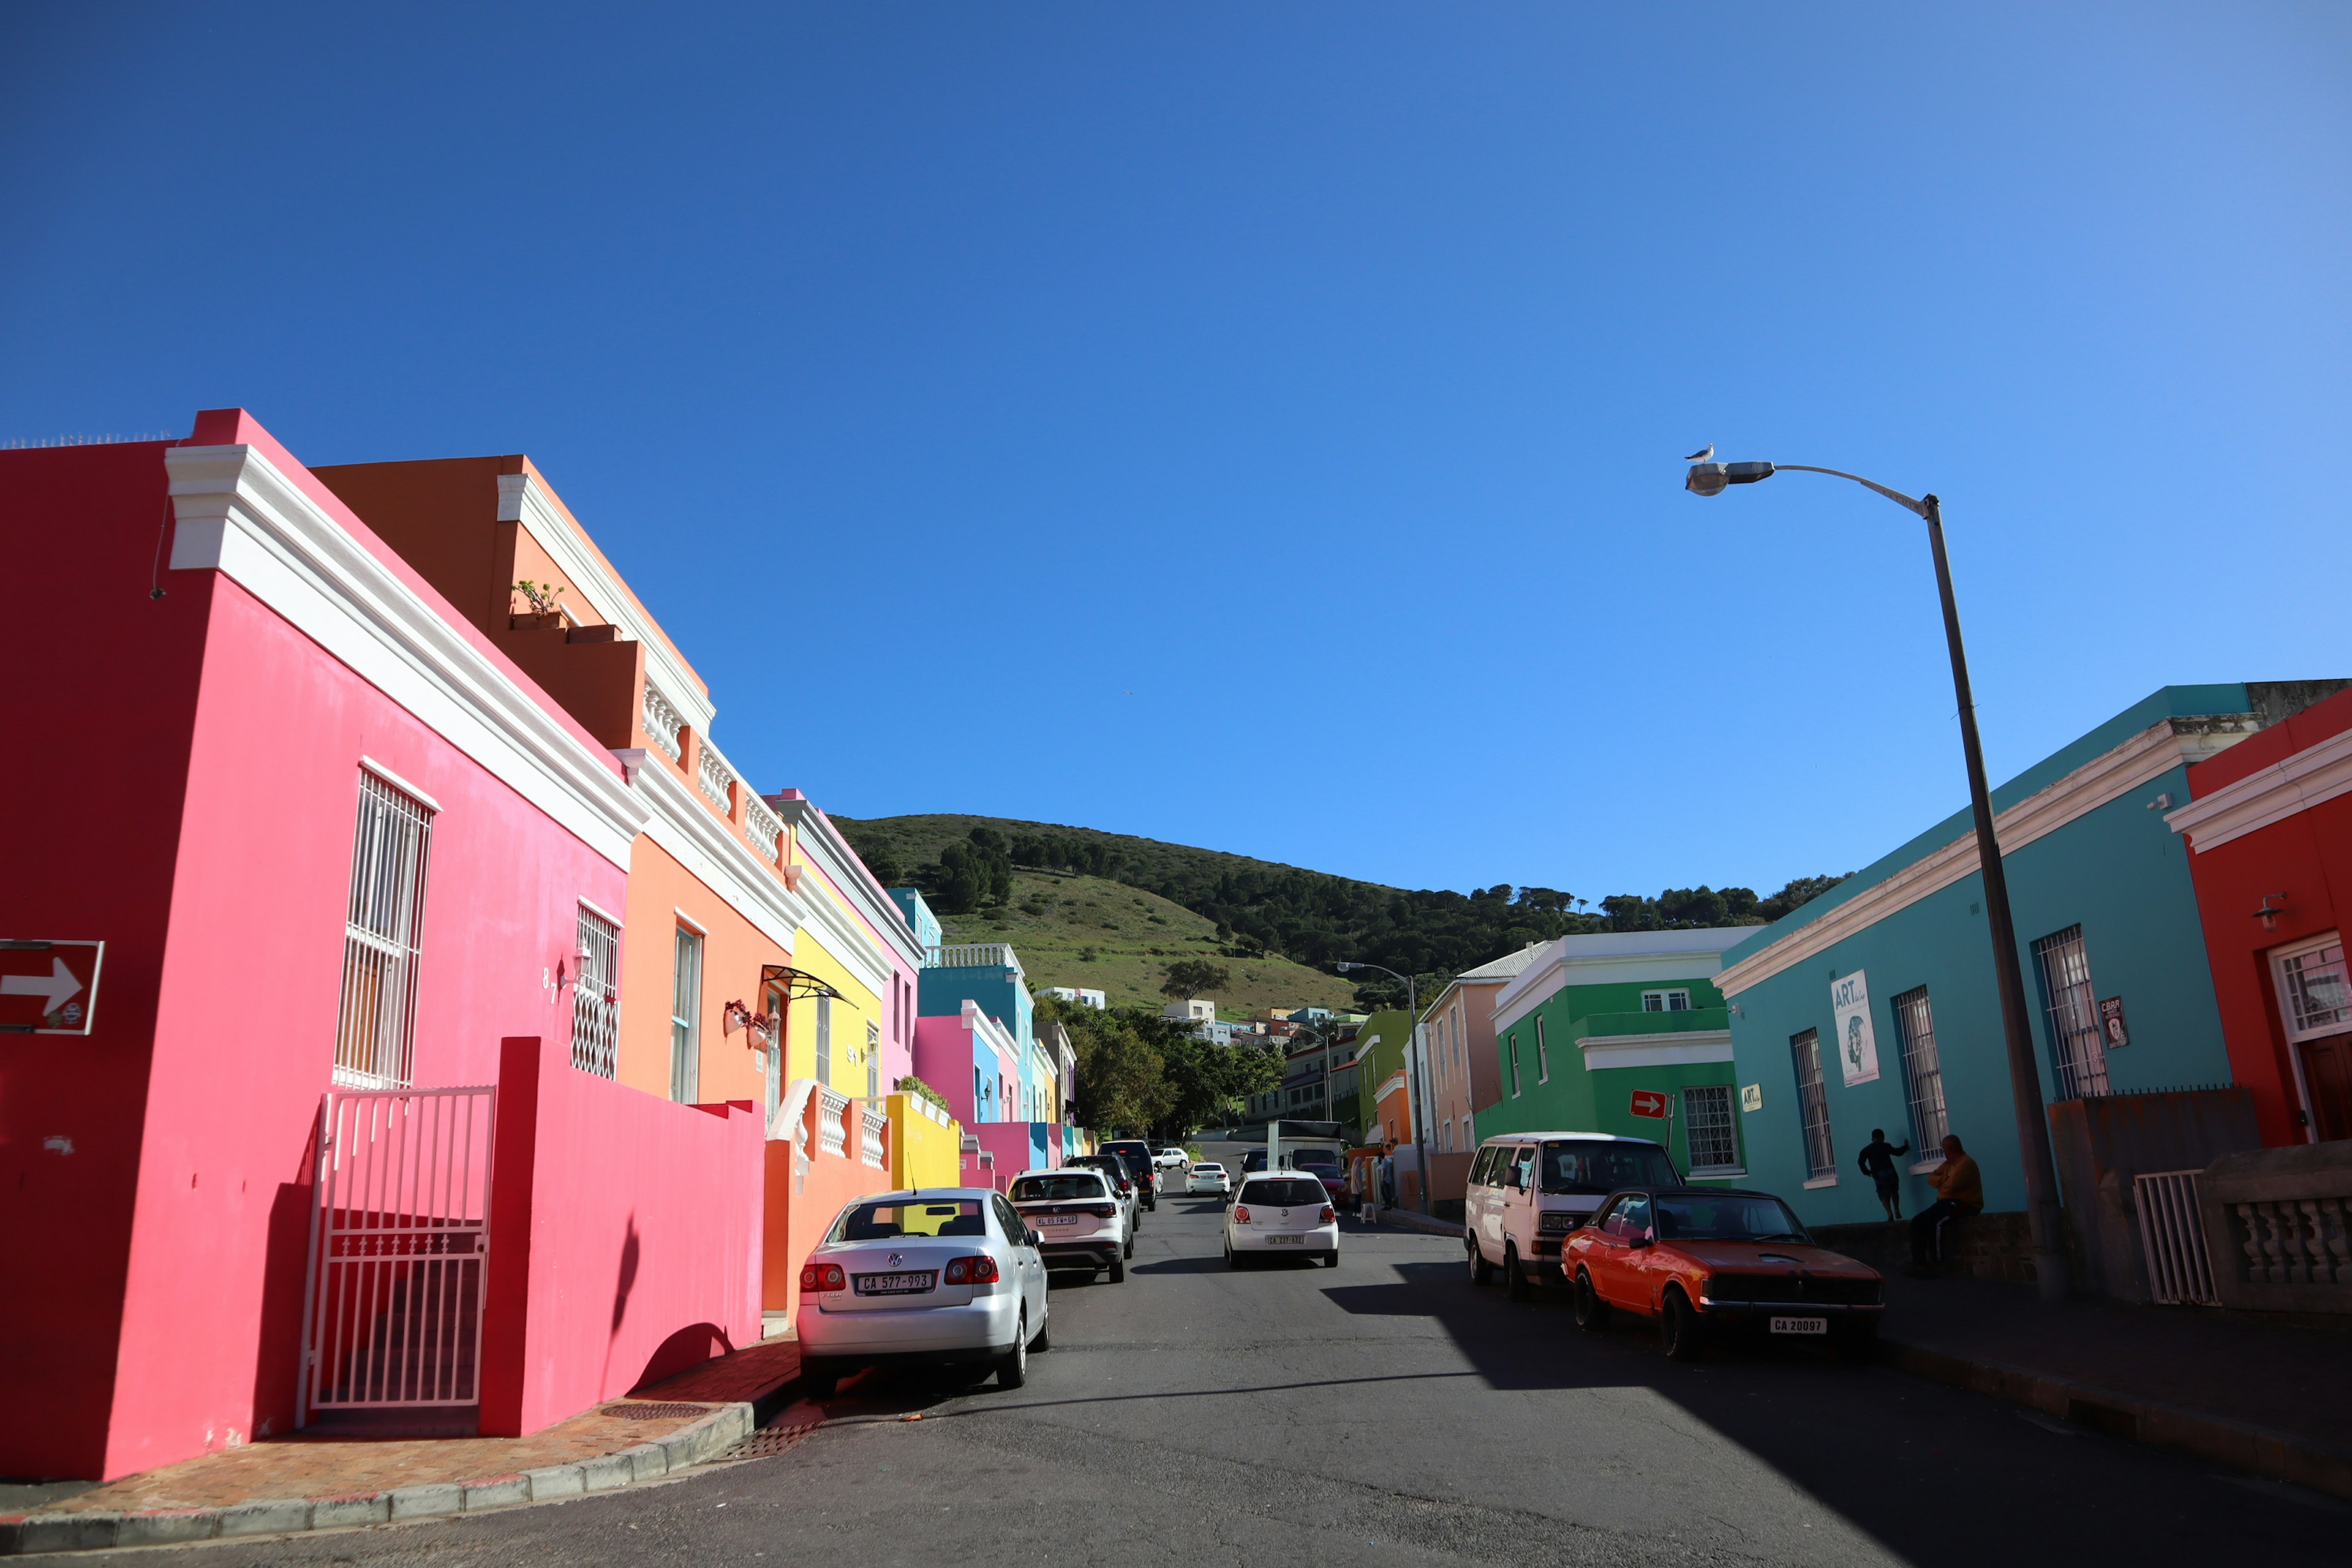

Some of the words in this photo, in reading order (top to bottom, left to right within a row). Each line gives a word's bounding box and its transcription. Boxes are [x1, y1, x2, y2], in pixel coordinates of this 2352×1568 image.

[543, 967, 557, 1005] 87
[1836, 979, 1855, 1010] ART
[847, 1044, 858, 1067] 91
[1744, 1088, 1754, 1105] ART
[864, 1278, 876, 1289] CA
[882, 1275, 927, 1289] 577-993
[1775, 1320, 1787, 1330] CA
[1791, 1321, 1821, 1331] 20097
